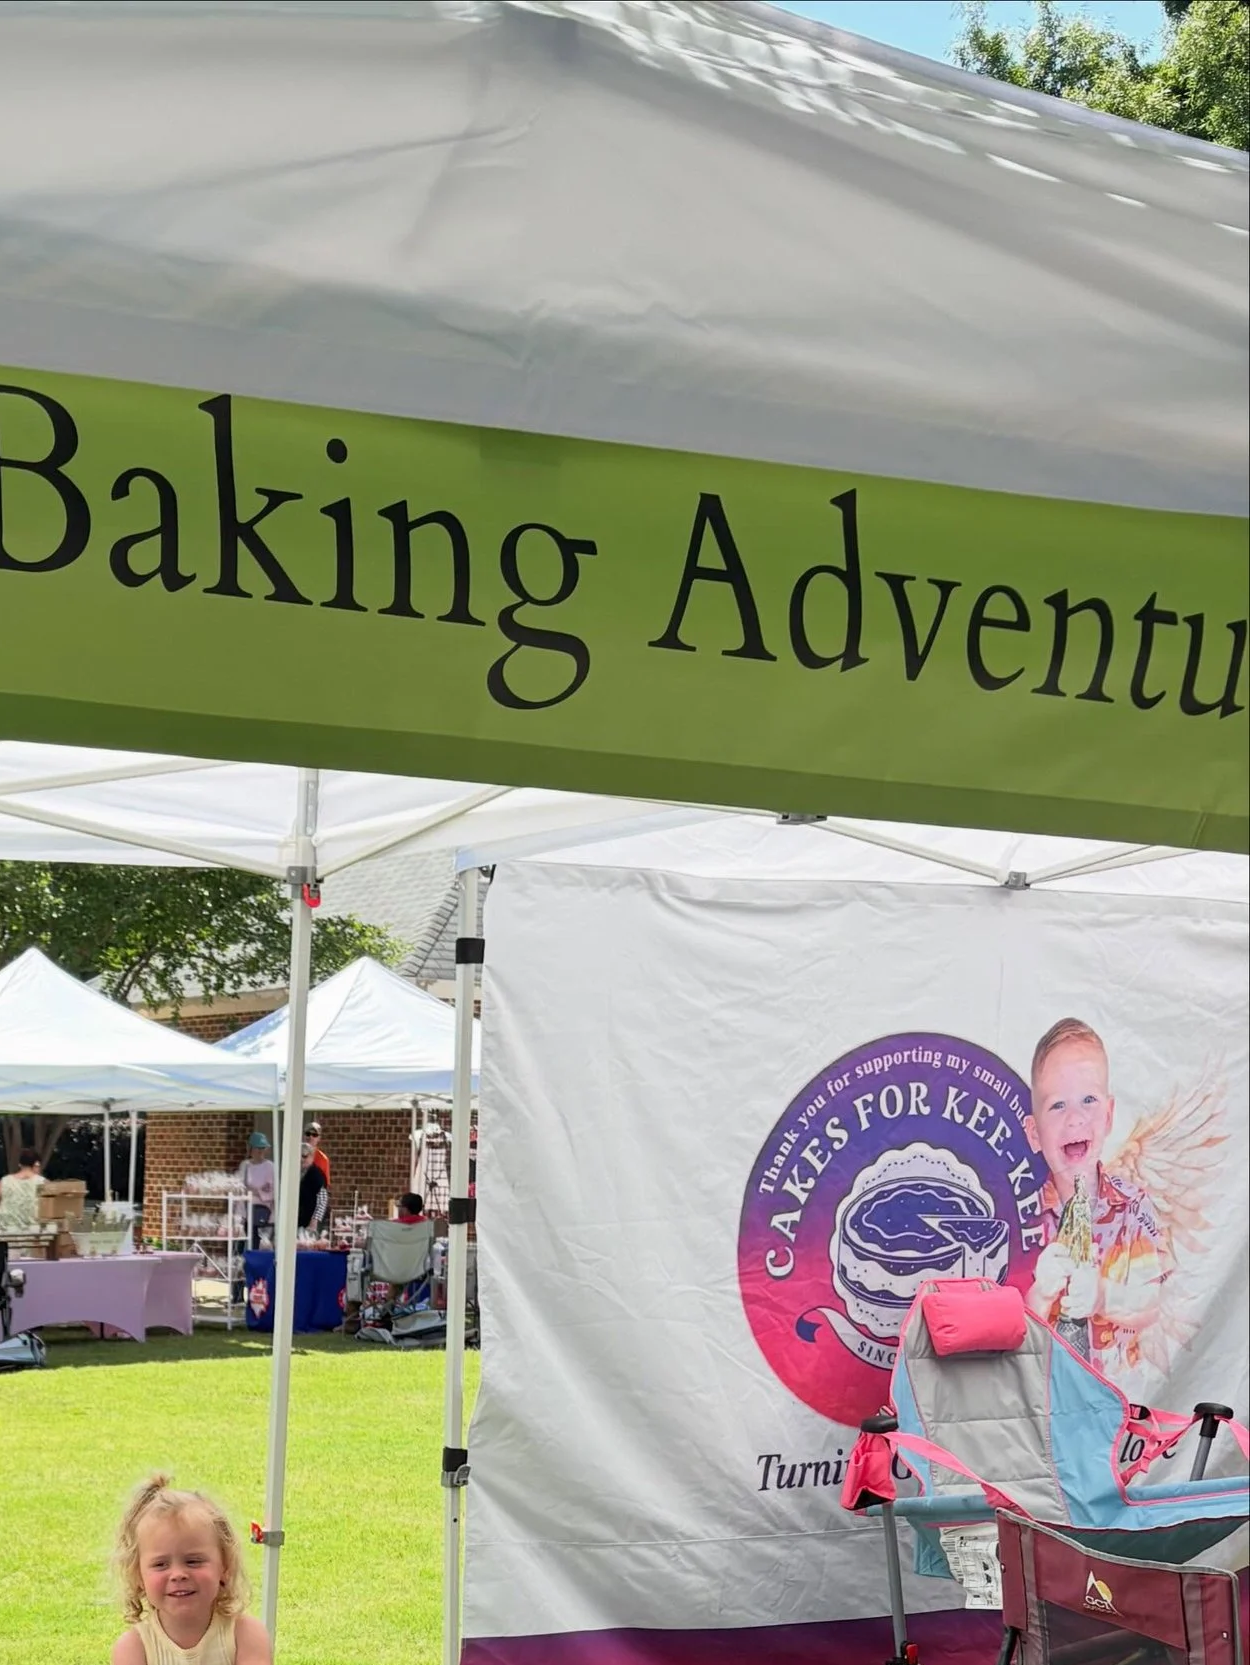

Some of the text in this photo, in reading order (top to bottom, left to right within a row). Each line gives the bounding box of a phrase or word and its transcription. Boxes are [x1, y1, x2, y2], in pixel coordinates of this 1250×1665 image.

[647, 488, 1248, 719] Adventu
[759, 1129, 800, 1194] Thank
[798, 1095, 827, 1130] you
[827, 1072, 851, 1097] for
[855, 1046, 942, 1078] supporting
[946, 1054, 971, 1075] my
[972, 1066, 1011, 1100] small
[765, 1082, 1046, 1281] CAKES FOR KEE-KEE
